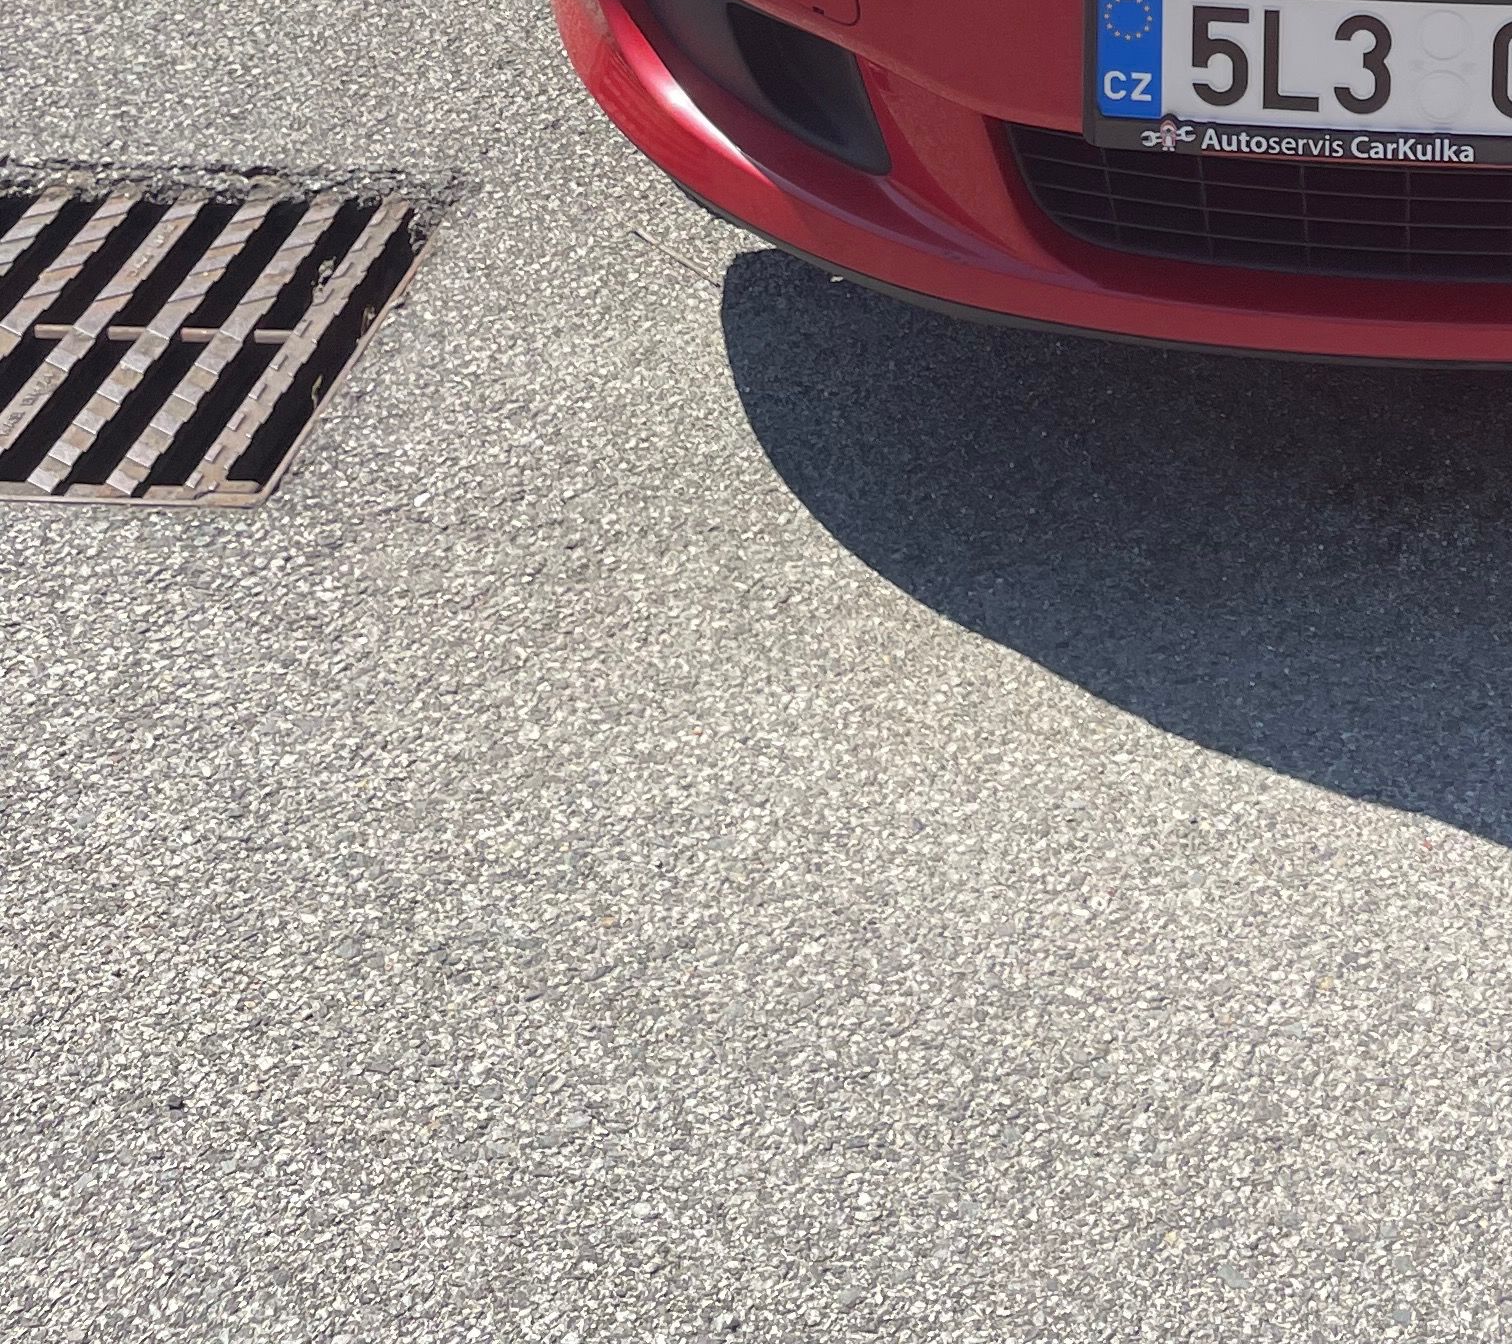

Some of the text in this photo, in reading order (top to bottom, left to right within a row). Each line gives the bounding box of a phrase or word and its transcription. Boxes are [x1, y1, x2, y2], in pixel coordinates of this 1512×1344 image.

[1191, 6, 1393, 114] 5L3
[1102, 70, 1153, 102] CZ
[1201, 128, 1475, 163] Autoservis CarKulka
